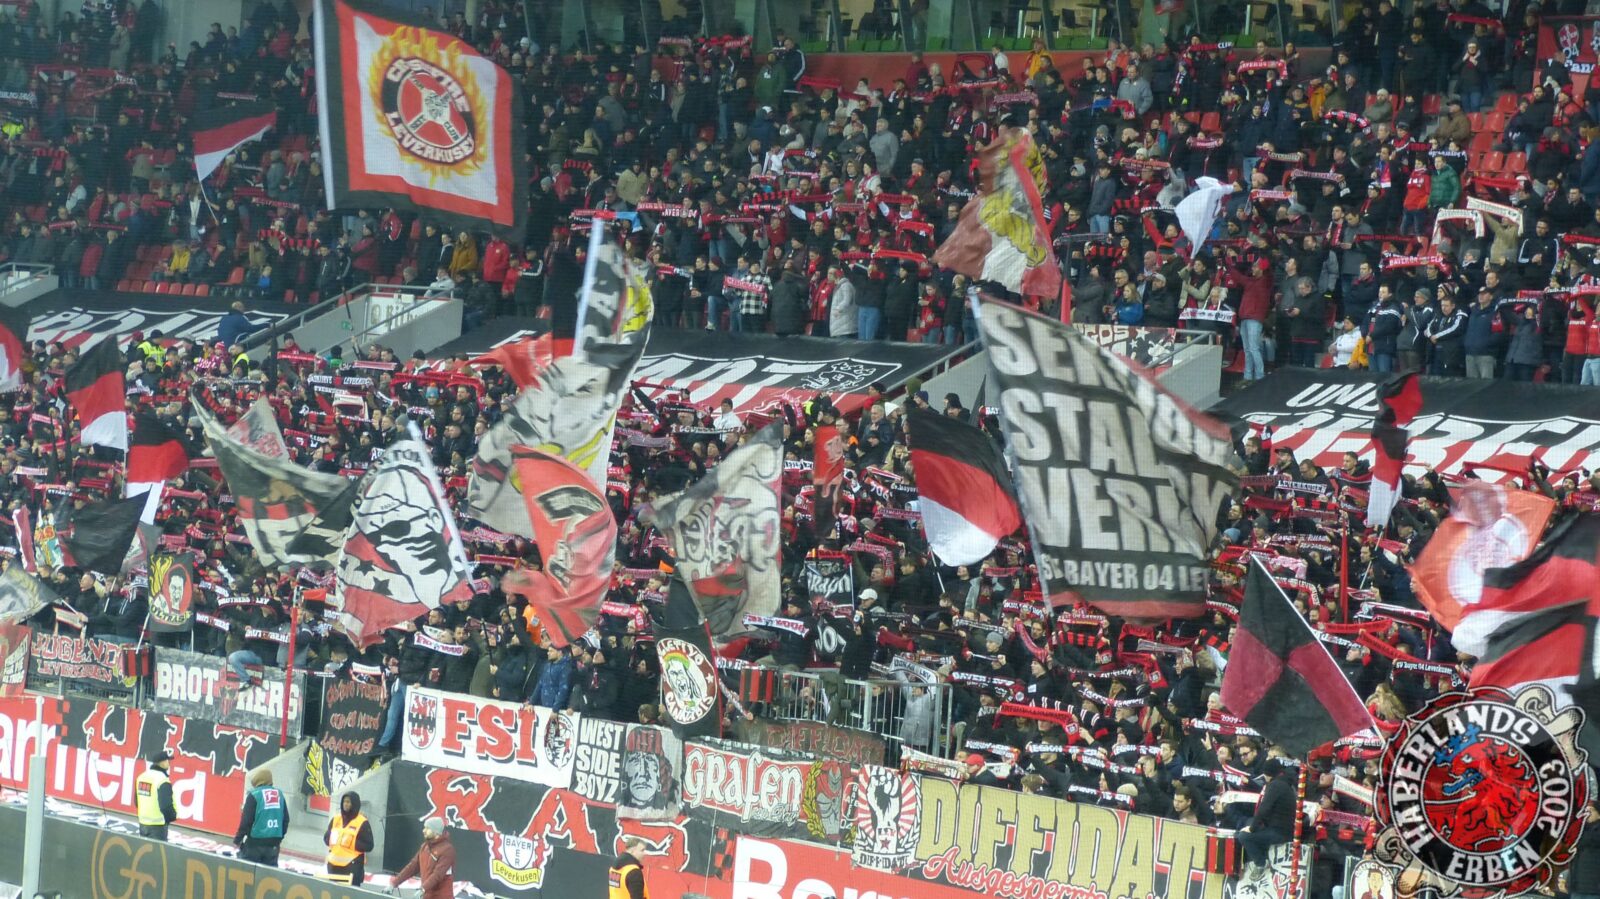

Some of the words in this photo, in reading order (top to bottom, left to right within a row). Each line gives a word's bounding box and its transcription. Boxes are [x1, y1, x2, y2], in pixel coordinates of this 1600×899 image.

[1277, 480, 1328, 494] LEVERKUSEN
[1063, 559, 1139, 590] BAYER
[1143, 563, 1175, 591] 04
[156, 662, 221, 706] BROT
[441, 697, 538, 769] FSI
[580, 719, 624, 749] WEST
[575, 745, 621, 779] SIDE
[574, 774, 621, 804] BOYZ
[505, 838, 532, 851] BAYER
[494, 861, 538, 882] Leverkusen
